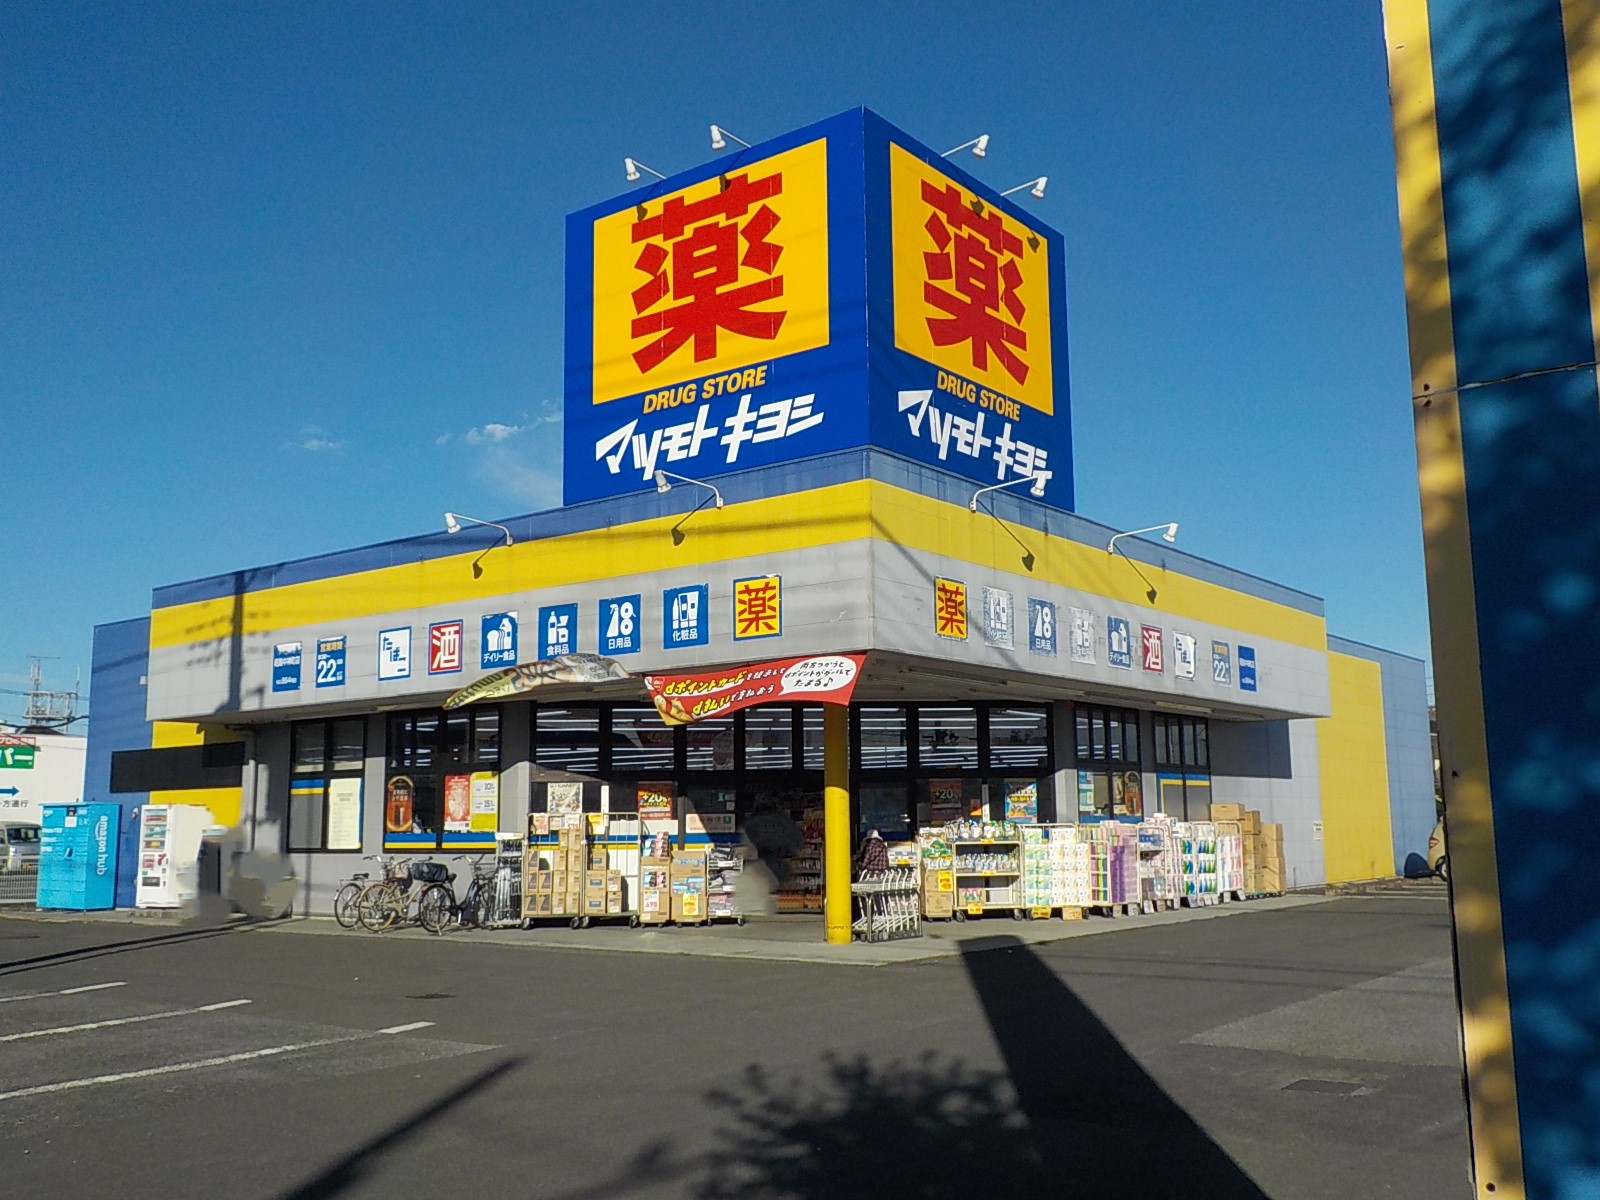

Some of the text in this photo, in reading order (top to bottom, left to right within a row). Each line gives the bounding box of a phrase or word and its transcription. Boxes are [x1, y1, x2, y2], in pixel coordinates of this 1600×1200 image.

[631, 171, 787, 374] 薬
[921, 178, 1029, 386] 薬
[643, 365, 768, 414] DRUG STORE
[937, 370, 1021, 421] DRUG STORE
[738, 581, 777, 634] 薬
[937, 583, 965, 635] 薬
[383, 636, 406, 672] たばこ
[432, 625, 460, 670] 酒
[546, 644, 570, 656] 食料品
[608, 637, 631, 649] 日用品
[672, 628, 698, 642] 化粧品
[1143, 629, 1162, 670] 酒
[317, 658, 337, 683] 22
[483, 650, 516, 663] デイリー食品
[1214, 660, 1226, 681] 22
[0, 799, 28, 808] 方通行
[97, 815, 109, 876] amazon hub
